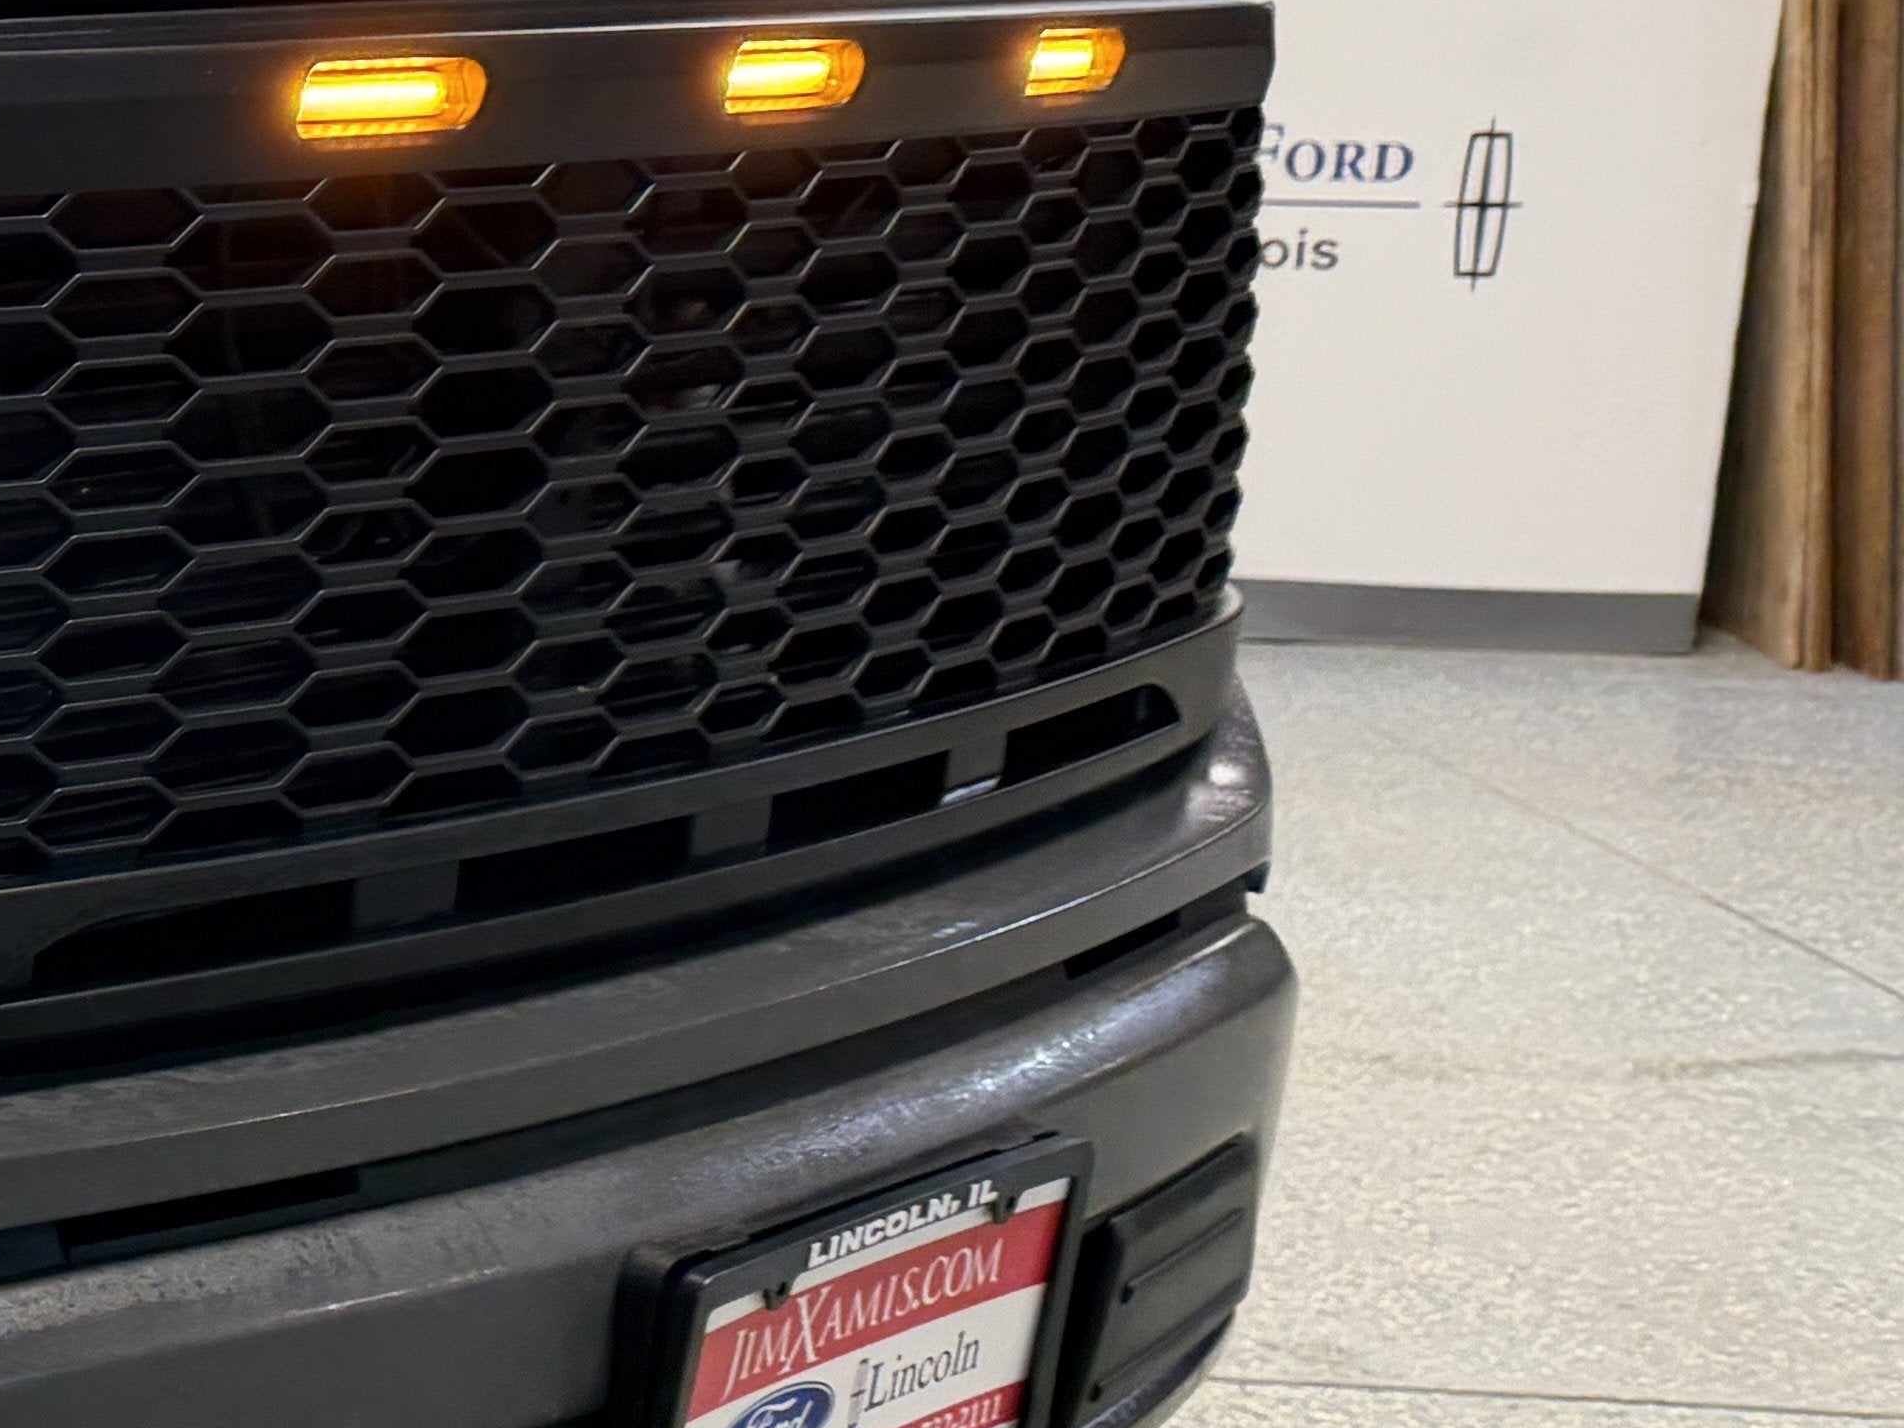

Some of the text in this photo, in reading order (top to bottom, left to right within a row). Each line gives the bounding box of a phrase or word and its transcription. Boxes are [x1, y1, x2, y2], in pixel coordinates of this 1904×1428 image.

[808, 1180, 998, 1268] LINCOLN, IL
[724, 1239, 1003, 1397] JIMXAMIS.COM
[863, 1331, 980, 1413] Lincoln
